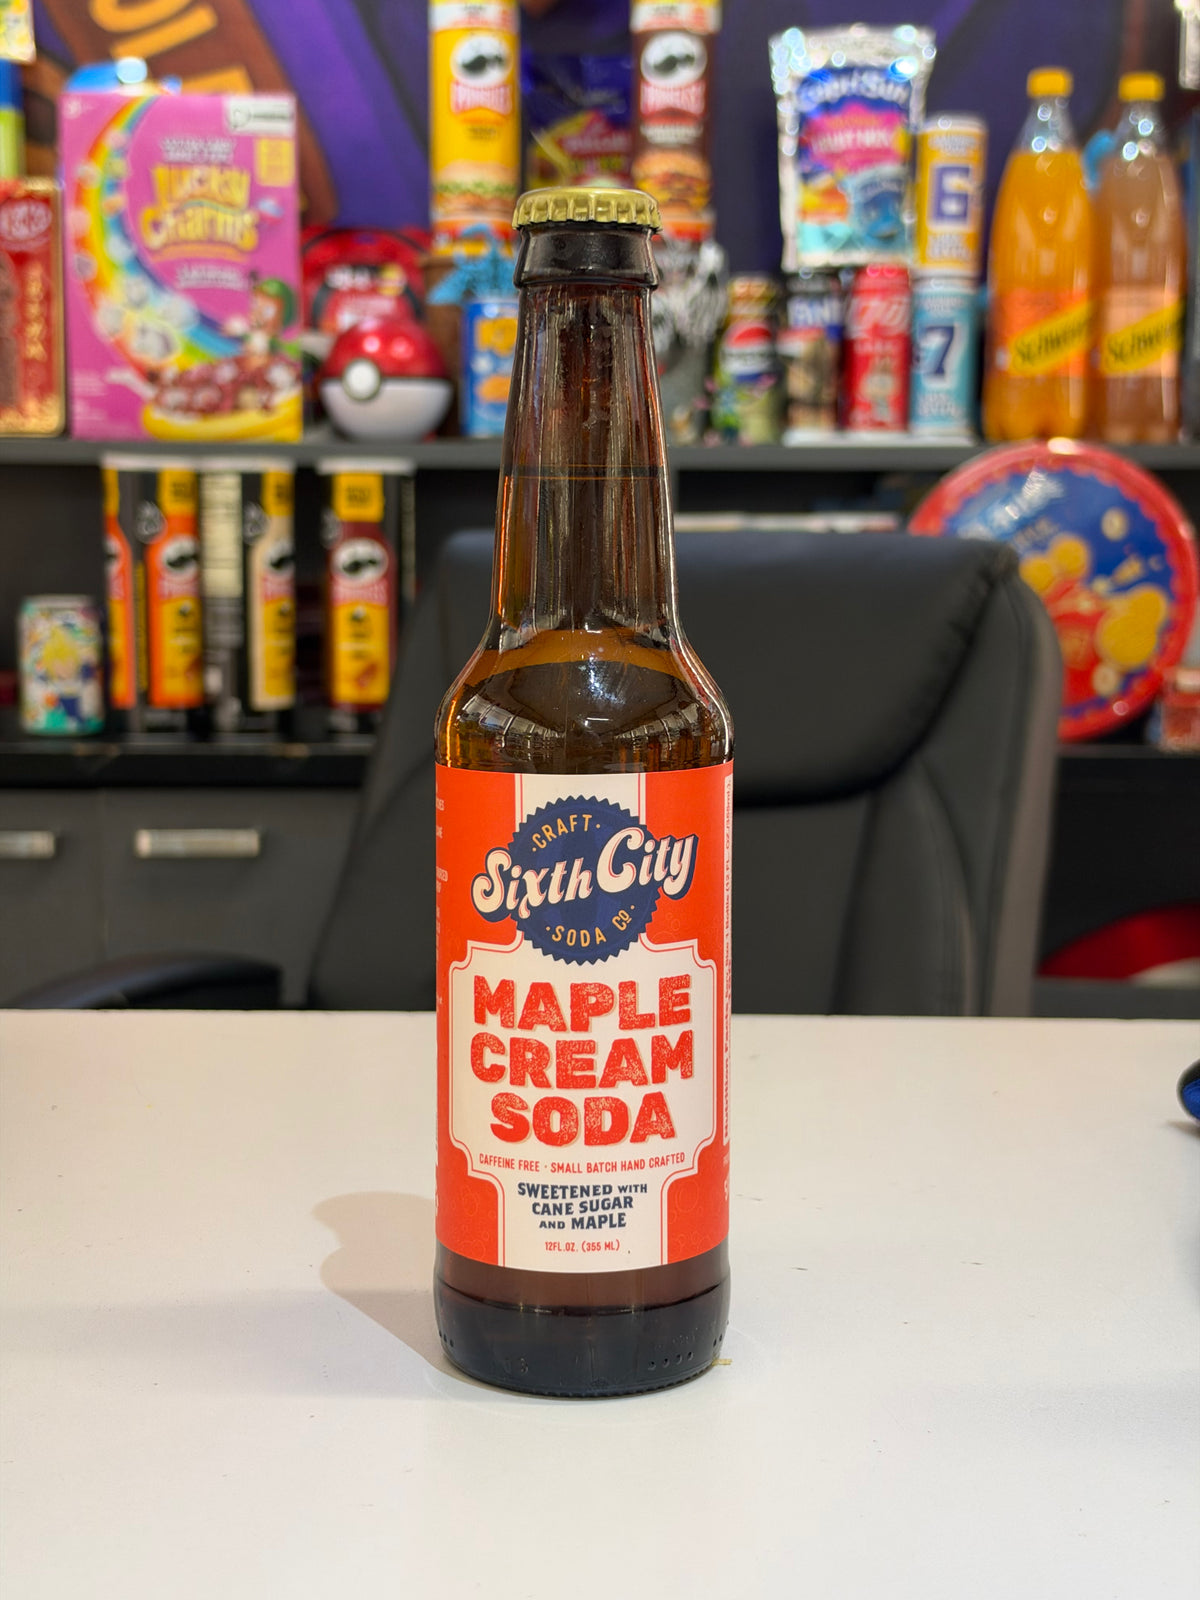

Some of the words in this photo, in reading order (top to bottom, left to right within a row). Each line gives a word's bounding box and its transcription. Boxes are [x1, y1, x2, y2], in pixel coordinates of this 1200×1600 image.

[533, 814, 592, 849] CRAFT
[472, 848, 594, 919] Sixth
[596, 827, 697, 897] City
[552, 925, 607, 947] SODA
[473, 974, 691, 1032] MAPLE
[470, 1030, 694, 1090] CREAM
[490, 1091, 676, 1147] SODA
[479, 1153, 515, 1170] CAFFEINE
[518, 1160, 540, 1172] FREE
[550, 1162, 583, 1174] SMALL
[586, 1161, 618, 1173] BATCH
[620, 1159, 646, 1171] HAND
[648, 1152, 685, 1169] CRAFTED
[517, 1182, 613, 1199] SWEETENED
[617, 1183, 648, 1194] WITH
[532, 1202, 574, 1216] CANE
[579, 1196, 634, 1214] SUGAR
[539, 1221, 566, 1230] AND
[571, 1213, 627, 1230] MAPLE
[581, 1240, 601, 1253] (355
[604, 1239, 621, 1252] ML)
